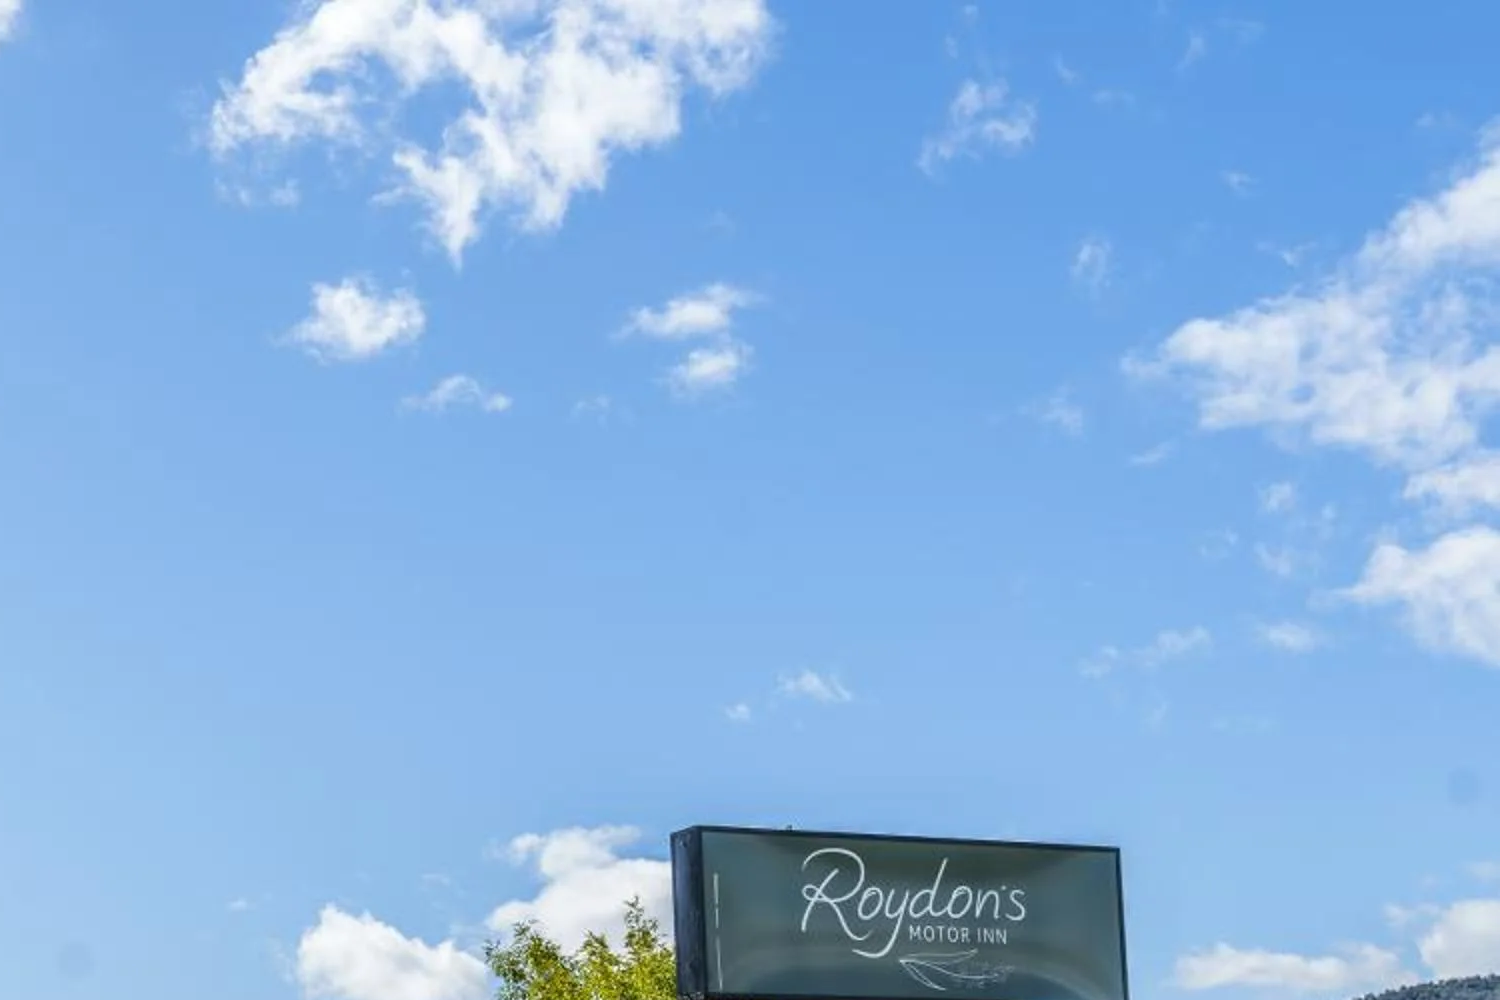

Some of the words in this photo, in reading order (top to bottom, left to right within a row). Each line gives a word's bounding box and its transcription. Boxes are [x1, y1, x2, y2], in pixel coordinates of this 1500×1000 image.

[802, 847, 1026, 958] Roydon's
[909, 925, 971, 943] MOTOR
[977, 927, 1007, 944] INN
